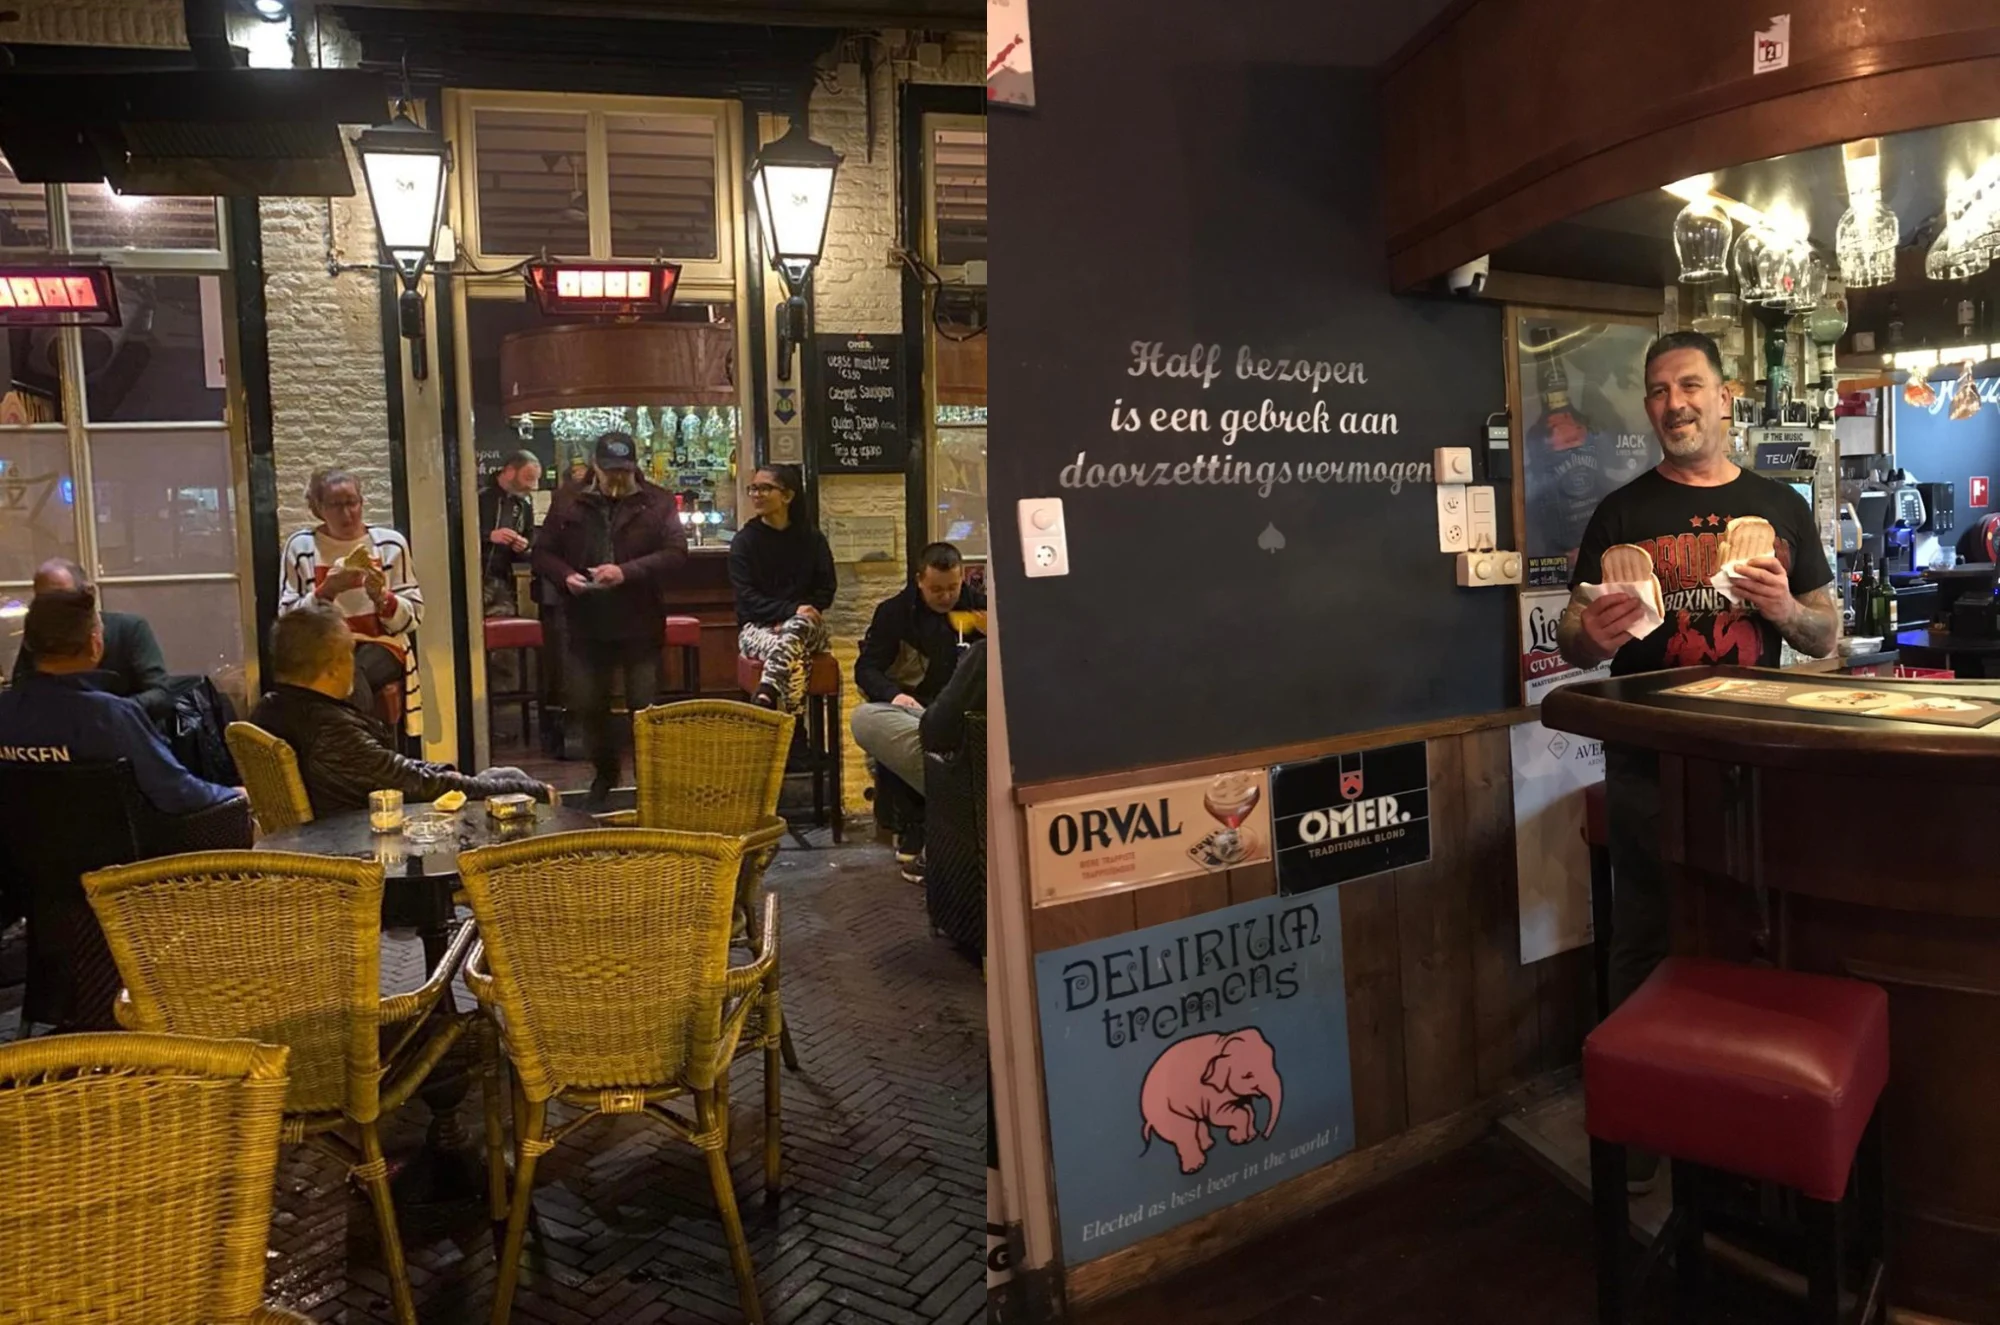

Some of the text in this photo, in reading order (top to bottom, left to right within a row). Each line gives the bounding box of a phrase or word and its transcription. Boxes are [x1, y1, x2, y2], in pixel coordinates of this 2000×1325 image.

[1127, 341, 1368, 393] Half bezopen
[1111, 398, 1399, 445] is een gebrek aan
[1616, 434, 1646, 448] JACK
[1763, 433, 1804, 441] IF THE MUSIC
[1059, 451, 1434, 498] doorzettingsvermogen
[1049, 798, 1184, 856] ORVAL
[1298, 796, 1411, 843] OMER.
[1308, 828, 1406, 858] TRADITIONAL BLOND
[1062, 903, 1321, 1012] DELIRIUM
[1082, 1204, 1144, 1242] Elected
[1148, 1200, 1167, 1217] as
[1170, 1183, 1202, 1209] best
[1207, 1171, 1239, 1194] beer
[1243, 1162, 1259, 1180] in
[1263, 1150, 1287, 1171] the
[1289, 1133, 1330, 1160] world
